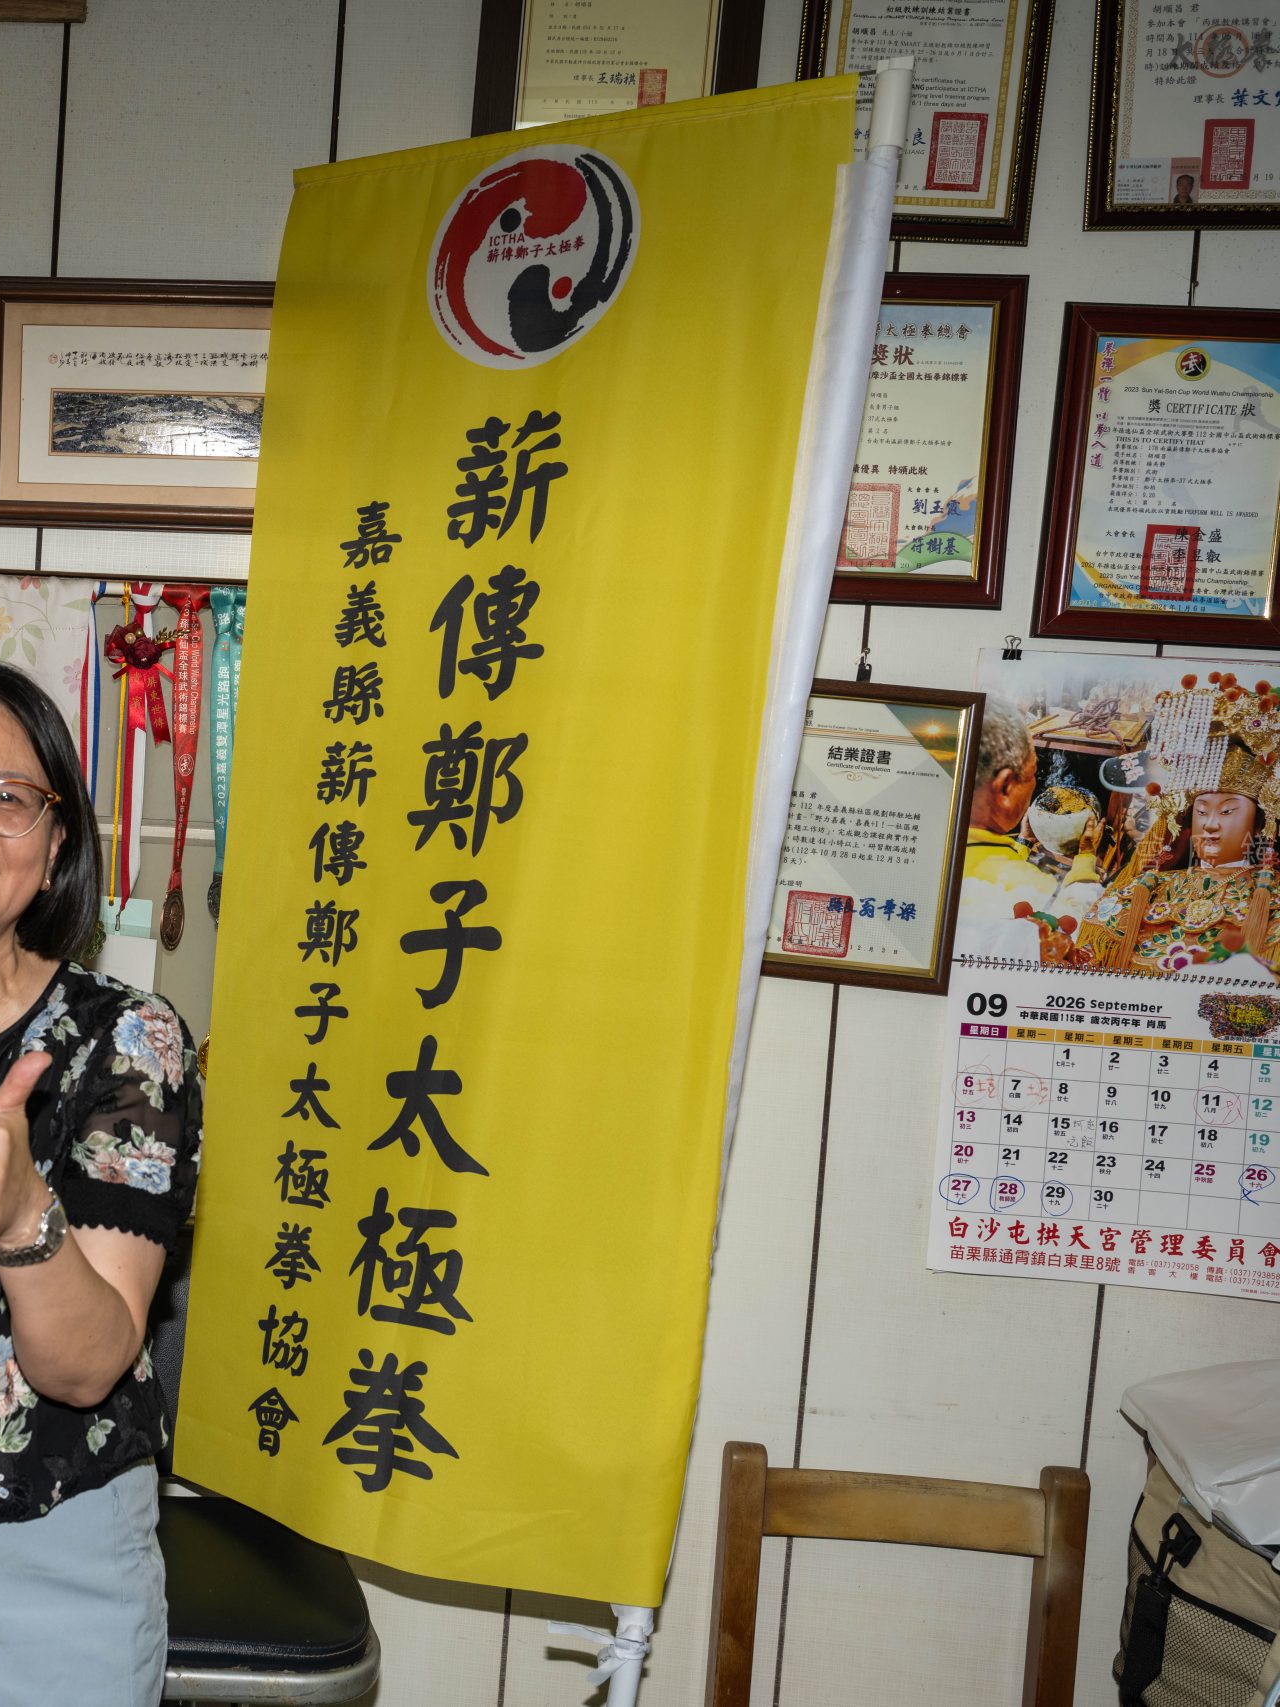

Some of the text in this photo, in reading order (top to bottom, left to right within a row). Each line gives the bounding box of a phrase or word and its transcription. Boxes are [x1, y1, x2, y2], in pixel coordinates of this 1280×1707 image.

[1152, 3, 1201, 14] 胡順昌 君
[1146, 19, 1186, 28] 參加本會
[1145, 34, 1175, 43] 時間為
[597, 72, 636, 86] 王瑞祺
[1154, 76, 1198, 86] 特給此證
[926, 85, 958, 93] participates
[941, 101, 954, 109] days
[1193, 94, 1225, 104] 理事長
[486, 235, 586, 264] 薪傳鄭子太極拳
[489, 233, 526, 247] ICTHA
[871, 343, 915, 366] 獎狀
[1097, 341, 1117, 402] 拳禪一體
[1178, 388, 1191, 397] Cup
[1232, 391, 1274, 400] Championship
[1166, 402, 1238, 416] CERTIFICATE
[1241, 403, 1256, 417] 狀
[888, 464, 928, 476] 特頒此狀
[907, 486, 939, 494] 大會會長
[912, 498, 961, 517] 劉玉霞
[1105, 529, 1136, 539] 大會會長
[827, 745, 892, 766] 結業證書
[826, 762, 854, 770] Certificate
[861, 764, 891, 773] completion
[321, 408, 568, 1495] 薪傳鄭子太極拳
[246, 498, 403, 1460] 嘉義縣薪傳鄭子太極拳協會
[966, 992, 1163, 1018] 09 2026 September
[1019, 1011, 1167, 1030] 中華民國115年 歲次丙午年 肖馬
[969, 1025, 1244, 1054] 星期日 星期一 星期二 星期三 星期四 星期五
[1062, 1048, 1271, 1075] 1 2 3 4 5
[963, 1076, 1273, 1111] 6 7 8 9 10 11 12
[956, 1110, 976, 1123] 13
[1003, 1113, 1023, 1126] 14
[1051, 1117, 1070, 1130] 15
[1099, 1120, 1119, 1133] 16
[1148, 1124, 1168, 1137] 17
[1197, 1128, 1218, 1141] 18
[1248, 1133, 1270, 1146] 19
[953, 1144, 1268, 1181] 20 21 22 23 24 25 26
[950, 1179, 1114, 1202] 27 28 29 30
[948, 1216, 1280, 1269] 白沙屯拱天宮管理委員會
[950, 1244, 1121, 1273] 苗栗縣通霄鎮白東里8號
